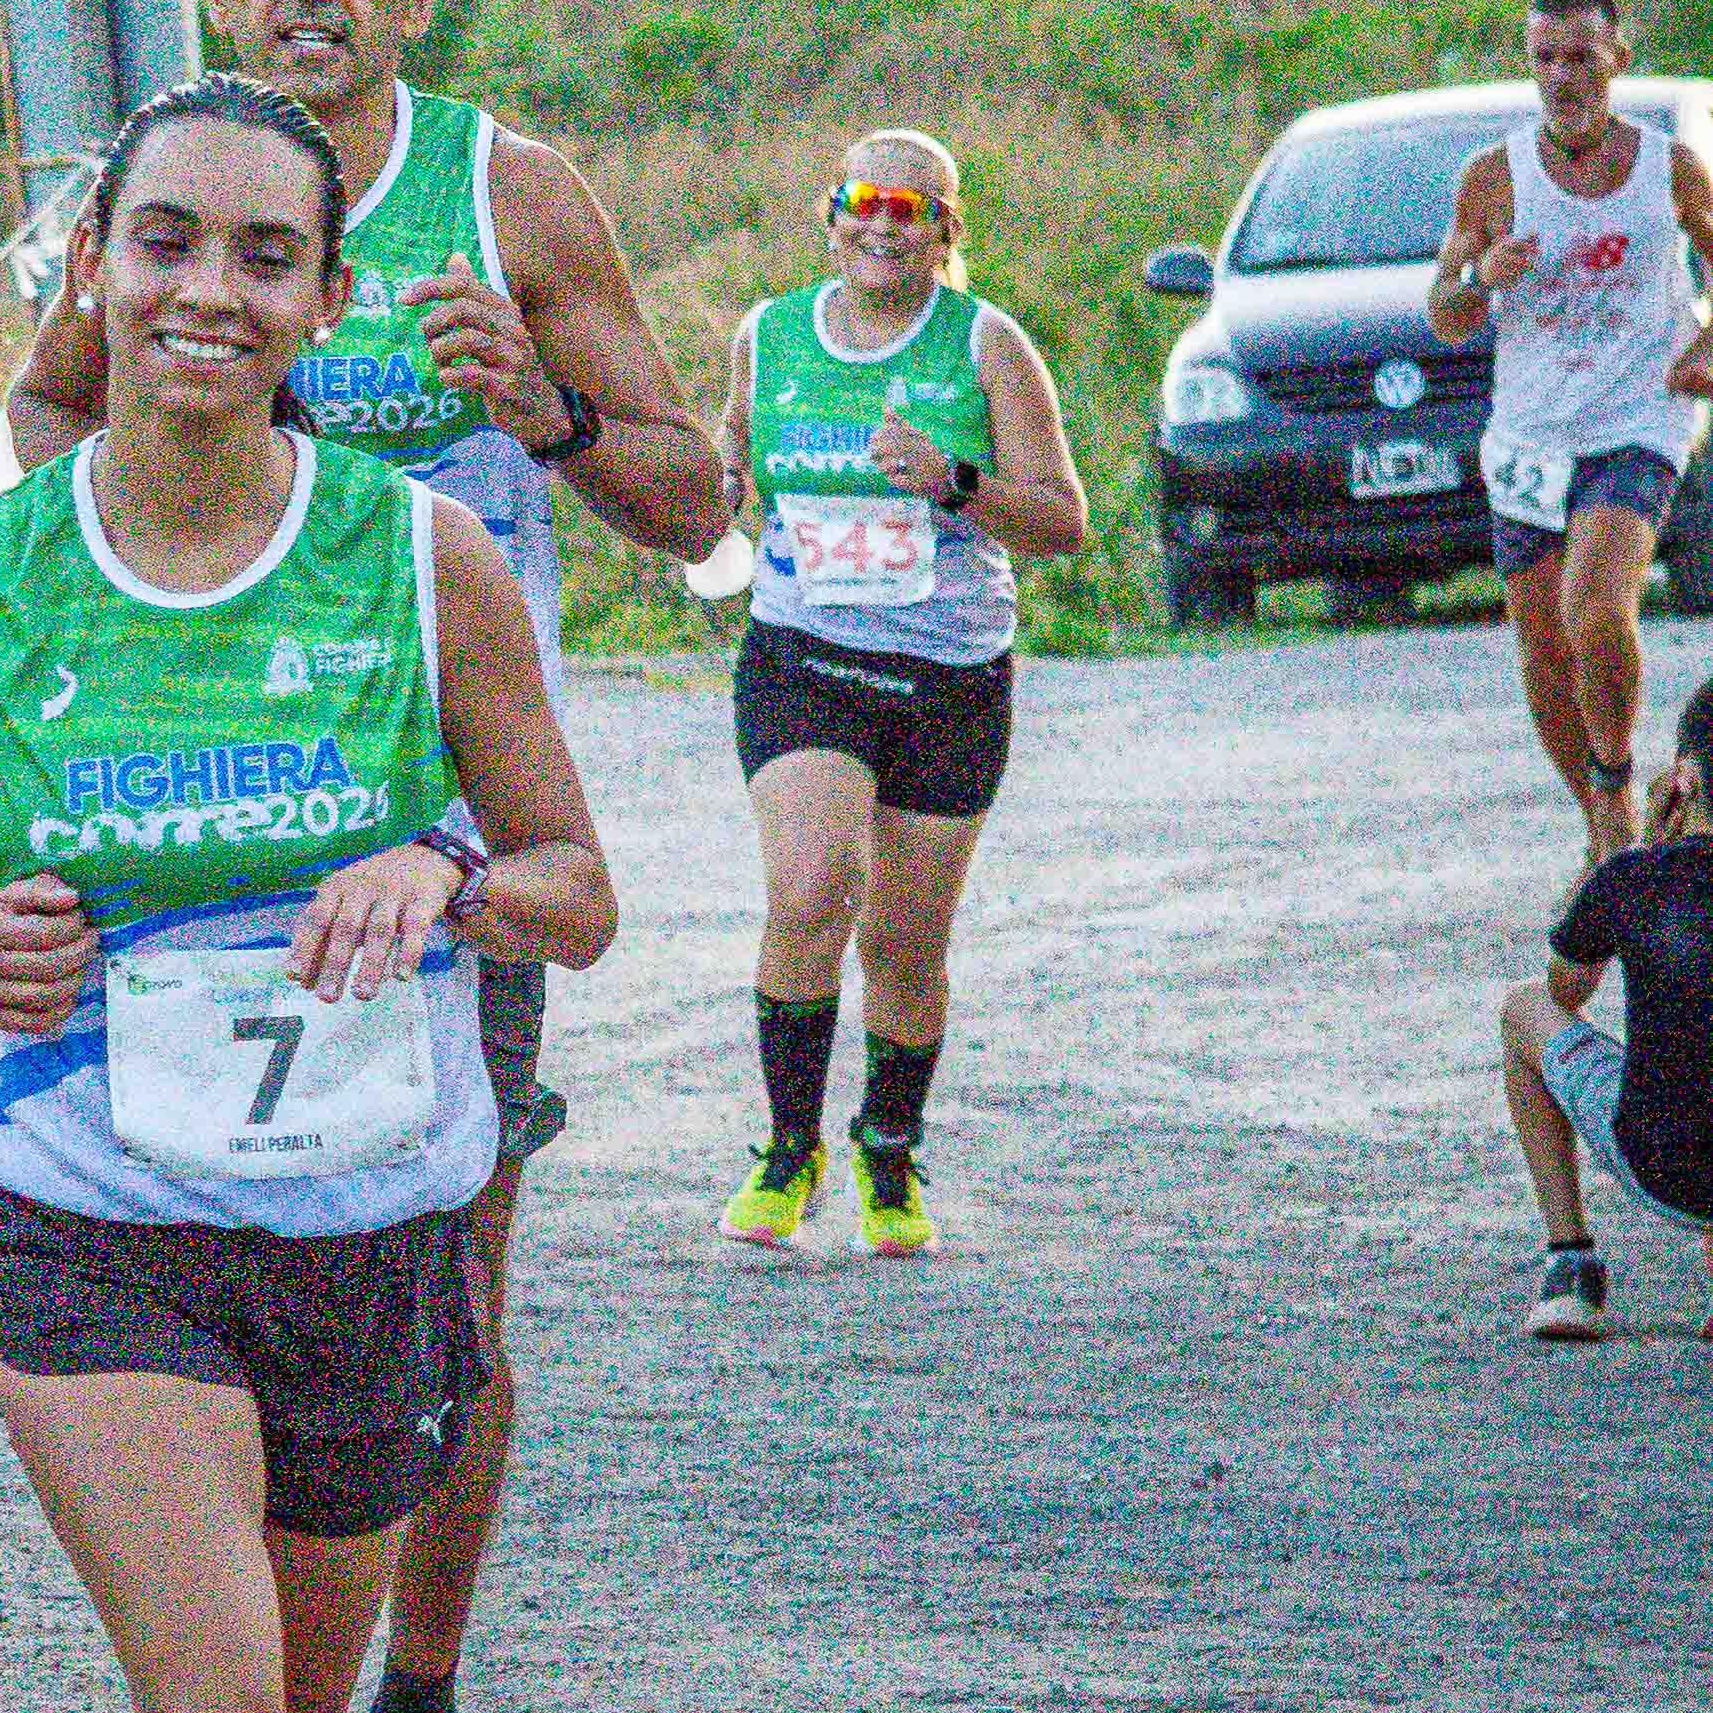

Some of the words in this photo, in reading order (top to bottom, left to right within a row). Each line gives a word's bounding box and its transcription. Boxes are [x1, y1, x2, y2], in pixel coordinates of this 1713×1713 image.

[794, 520, 920, 573] 543
[66, 736, 355, 813] FIGHIERA
[232, 1014, 306, 1126] 7
[268, 1133, 324, 1153] PERALTA
